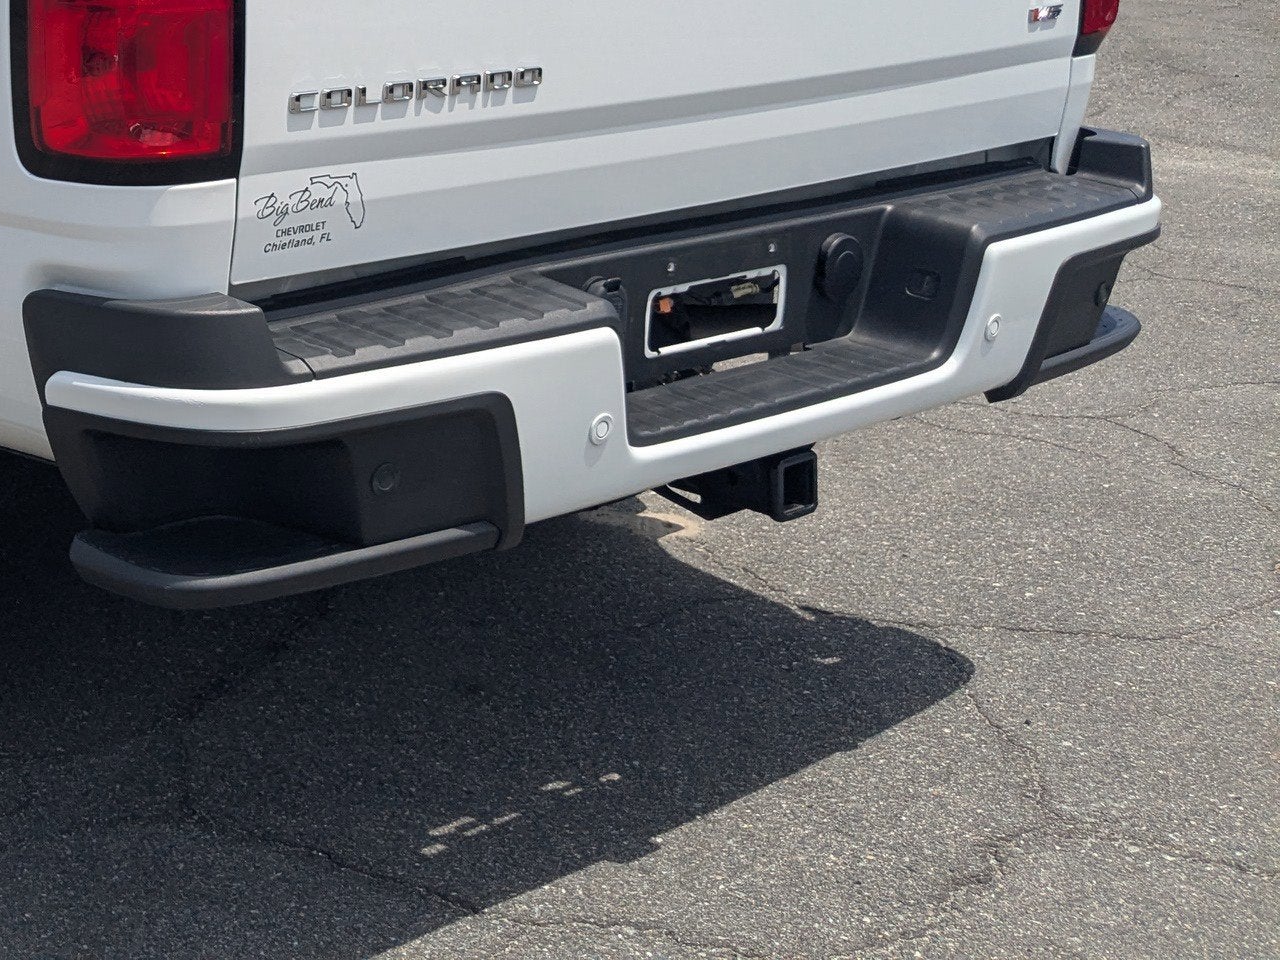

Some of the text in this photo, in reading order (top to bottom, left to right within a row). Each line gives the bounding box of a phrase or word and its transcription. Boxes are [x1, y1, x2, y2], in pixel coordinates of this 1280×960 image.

[288, 66, 543, 115] COLORADO
[254, 187, 338, 227] Big Bend
[263, 232, 332, 253] Chiefland, FL
[275, 220, 327, 238] CHEVROLET
